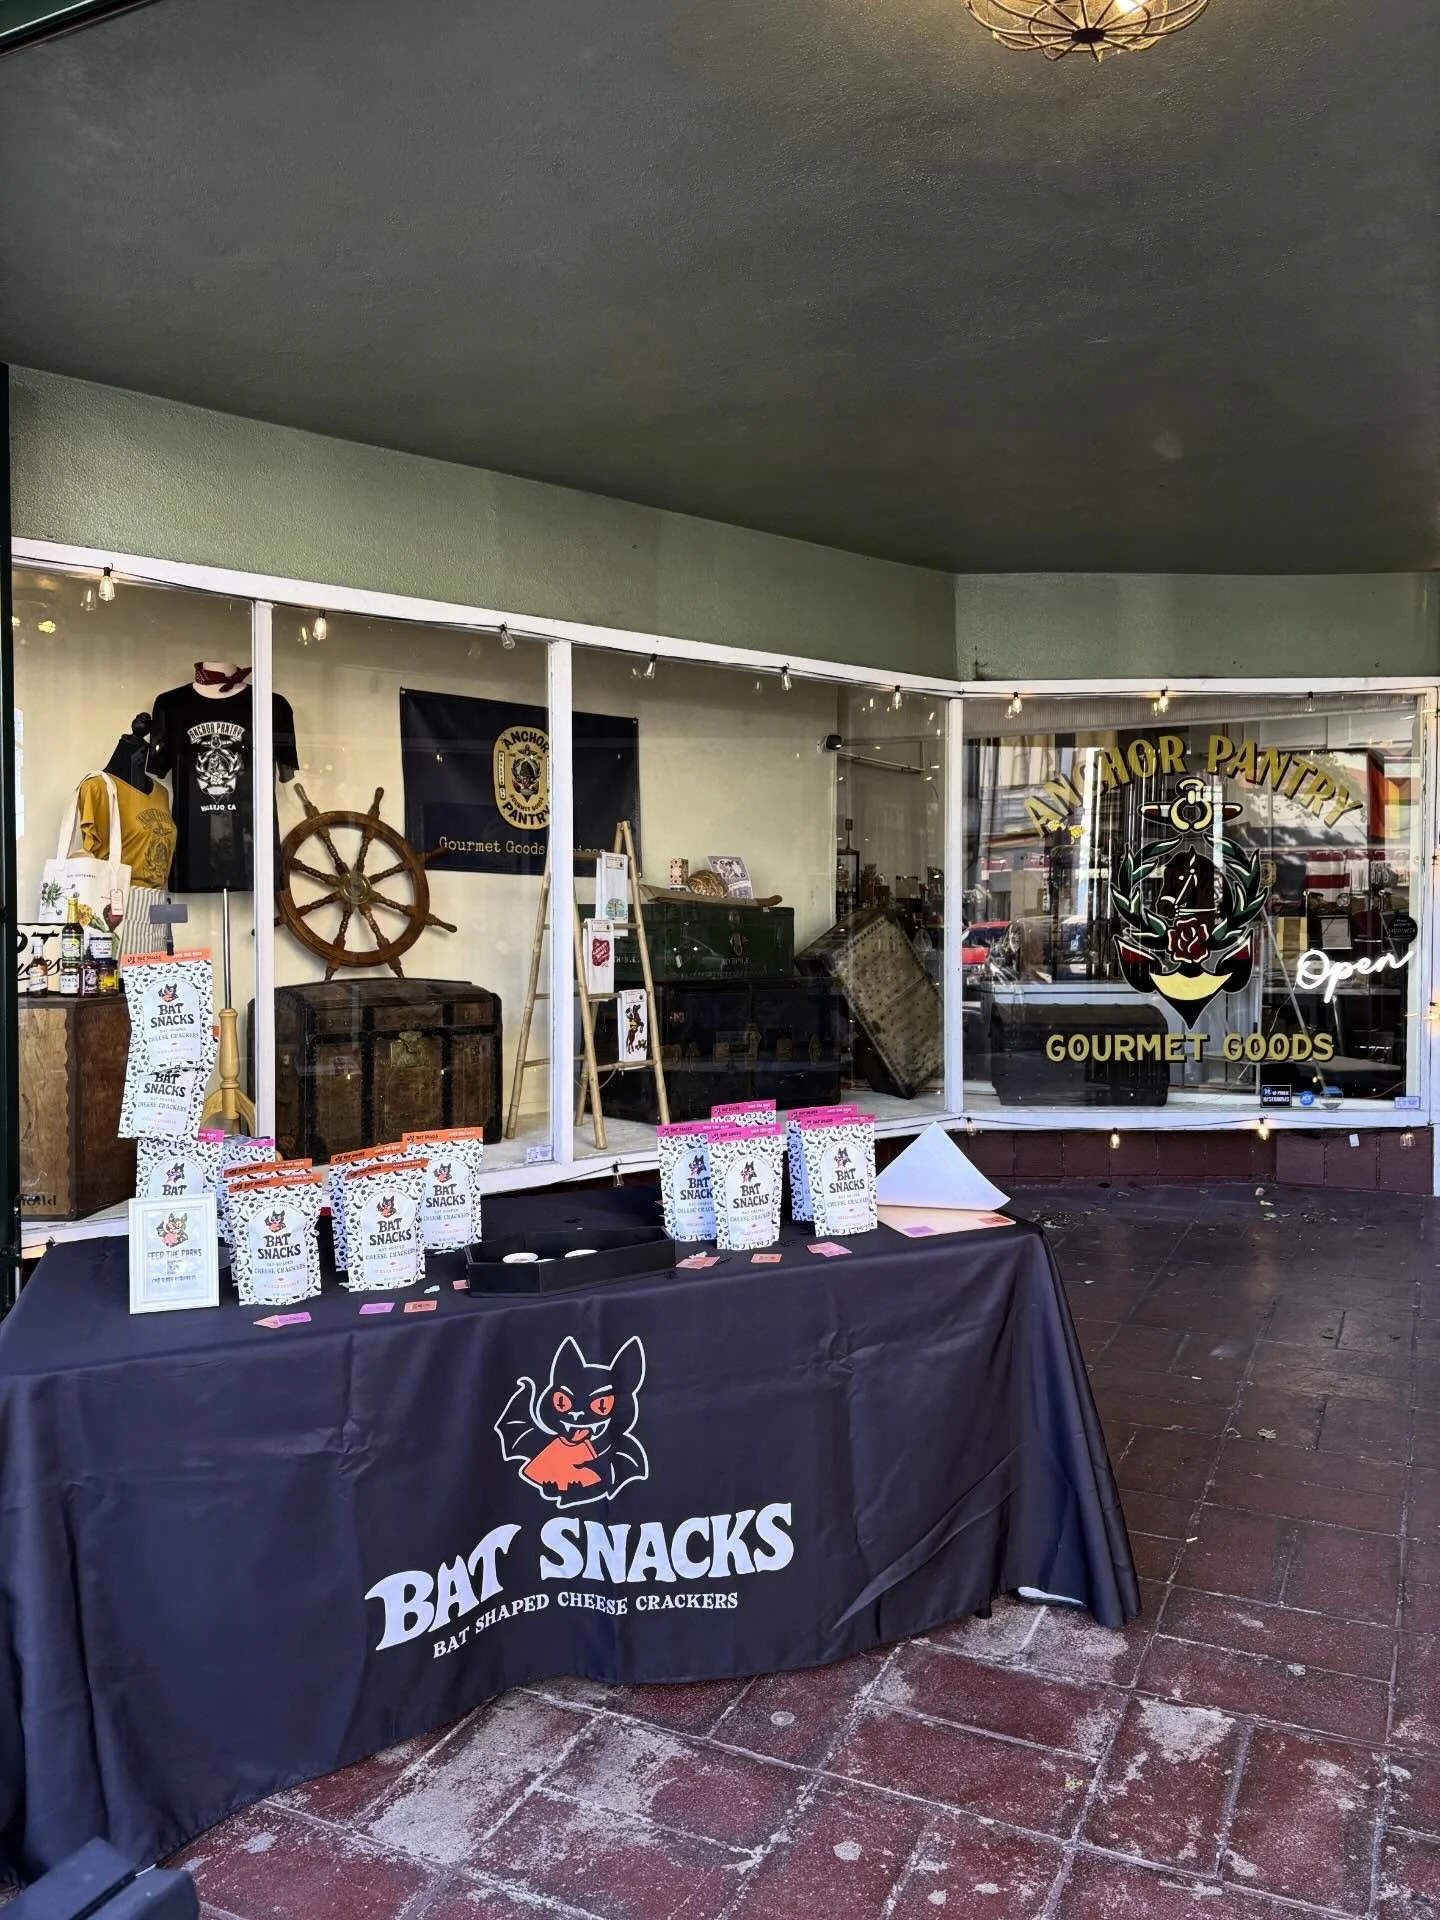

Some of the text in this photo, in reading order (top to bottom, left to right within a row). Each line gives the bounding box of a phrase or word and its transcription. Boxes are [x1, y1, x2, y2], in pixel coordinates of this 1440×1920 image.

[503, 731, 549, 753] ANCHOR
[1207, 735, 1363, 830] PANTRY
[503, 802, 550, 825] PANTRY
[440, 836, 502, 853] Gourmet
[506, 840, 546, 855] Goods
[1296, 949, 1414, 1003] Open
[157, 1003, 184, 1016] BAT
[150, 1013, 194, 1028] SNACKS
[1046, 1033, 1334, 1063] GOURMET GOODS
[154, 1072, 181, 1085] BAT
[143, 1082, 186, 1098] SNACKS
[836, 1168, 856, 1182] BAT
[162, 1184, 188, 1196] BAT
[433, 1184, 457, 1197] BAT
[688, 1177, 710, 1189] BAT
[740, 1182, 761, 1196] BAT
[829, 1178, 865, 1194] SNACKS
[426, 1194, 466, 1208] SNACKS
[680, 1188, 713, 1201] SNACK
[732, 1194, 770, 1209] SNACKS
[377, 1218, 403, 1232] BAT
[264, 1232, 292, 1247] BAT
[369, 1228, 412, 1246] SNACKS
[258, 1244, 301, 1260] SNACKS
[364, 1502, 794, 1651] BAT SNACKS
[433, 1591, 738, 1658] BAT SHAPED CHEESE CRACKERS
